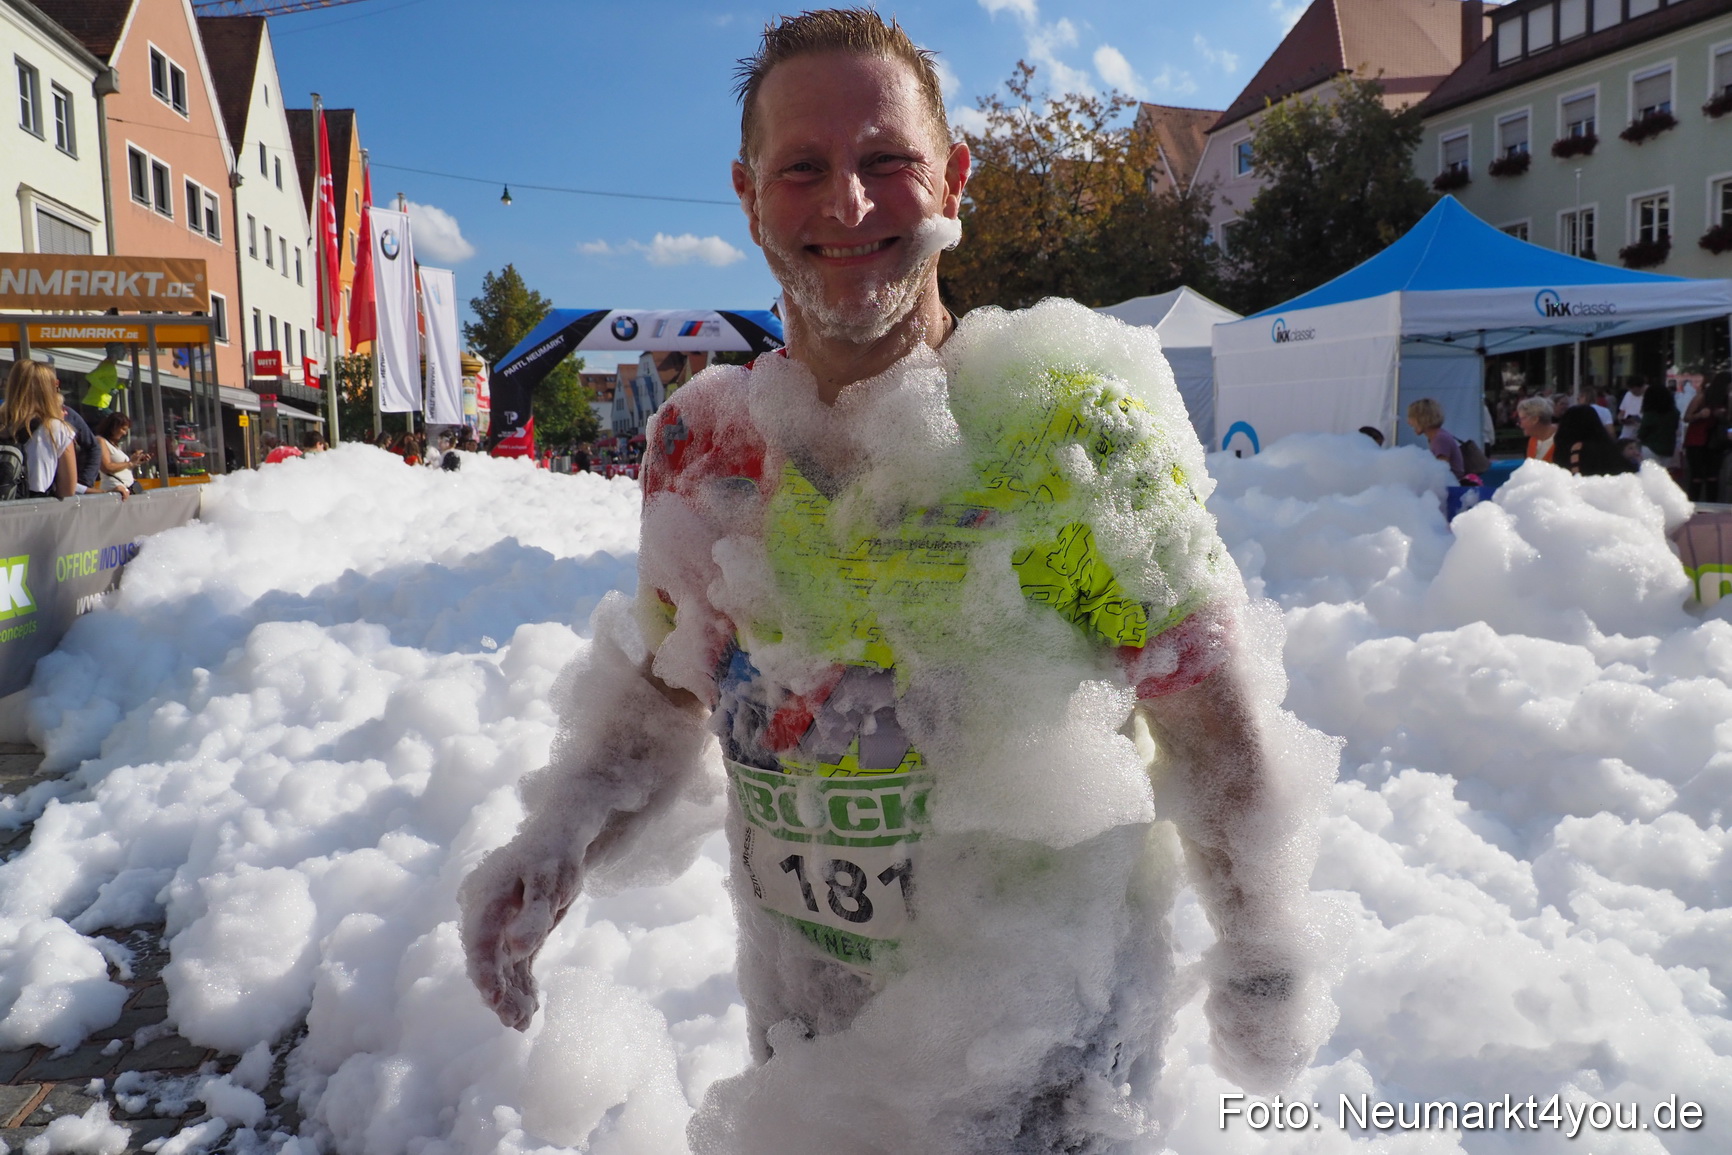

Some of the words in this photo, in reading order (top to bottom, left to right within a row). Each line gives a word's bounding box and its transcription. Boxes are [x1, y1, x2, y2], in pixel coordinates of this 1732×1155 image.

[1572, 301, 1617, 317] classic
[40, 327, 139, 339] RUNMARKT.DE
[257, 358, 277, 366] WITT
[503, 359, 527, 378] PARTL
[525, 334, 565, 363] NEUMARKT
[56, 549, 98, 583] OFFICE
[779, 853, 918, 923] 181
